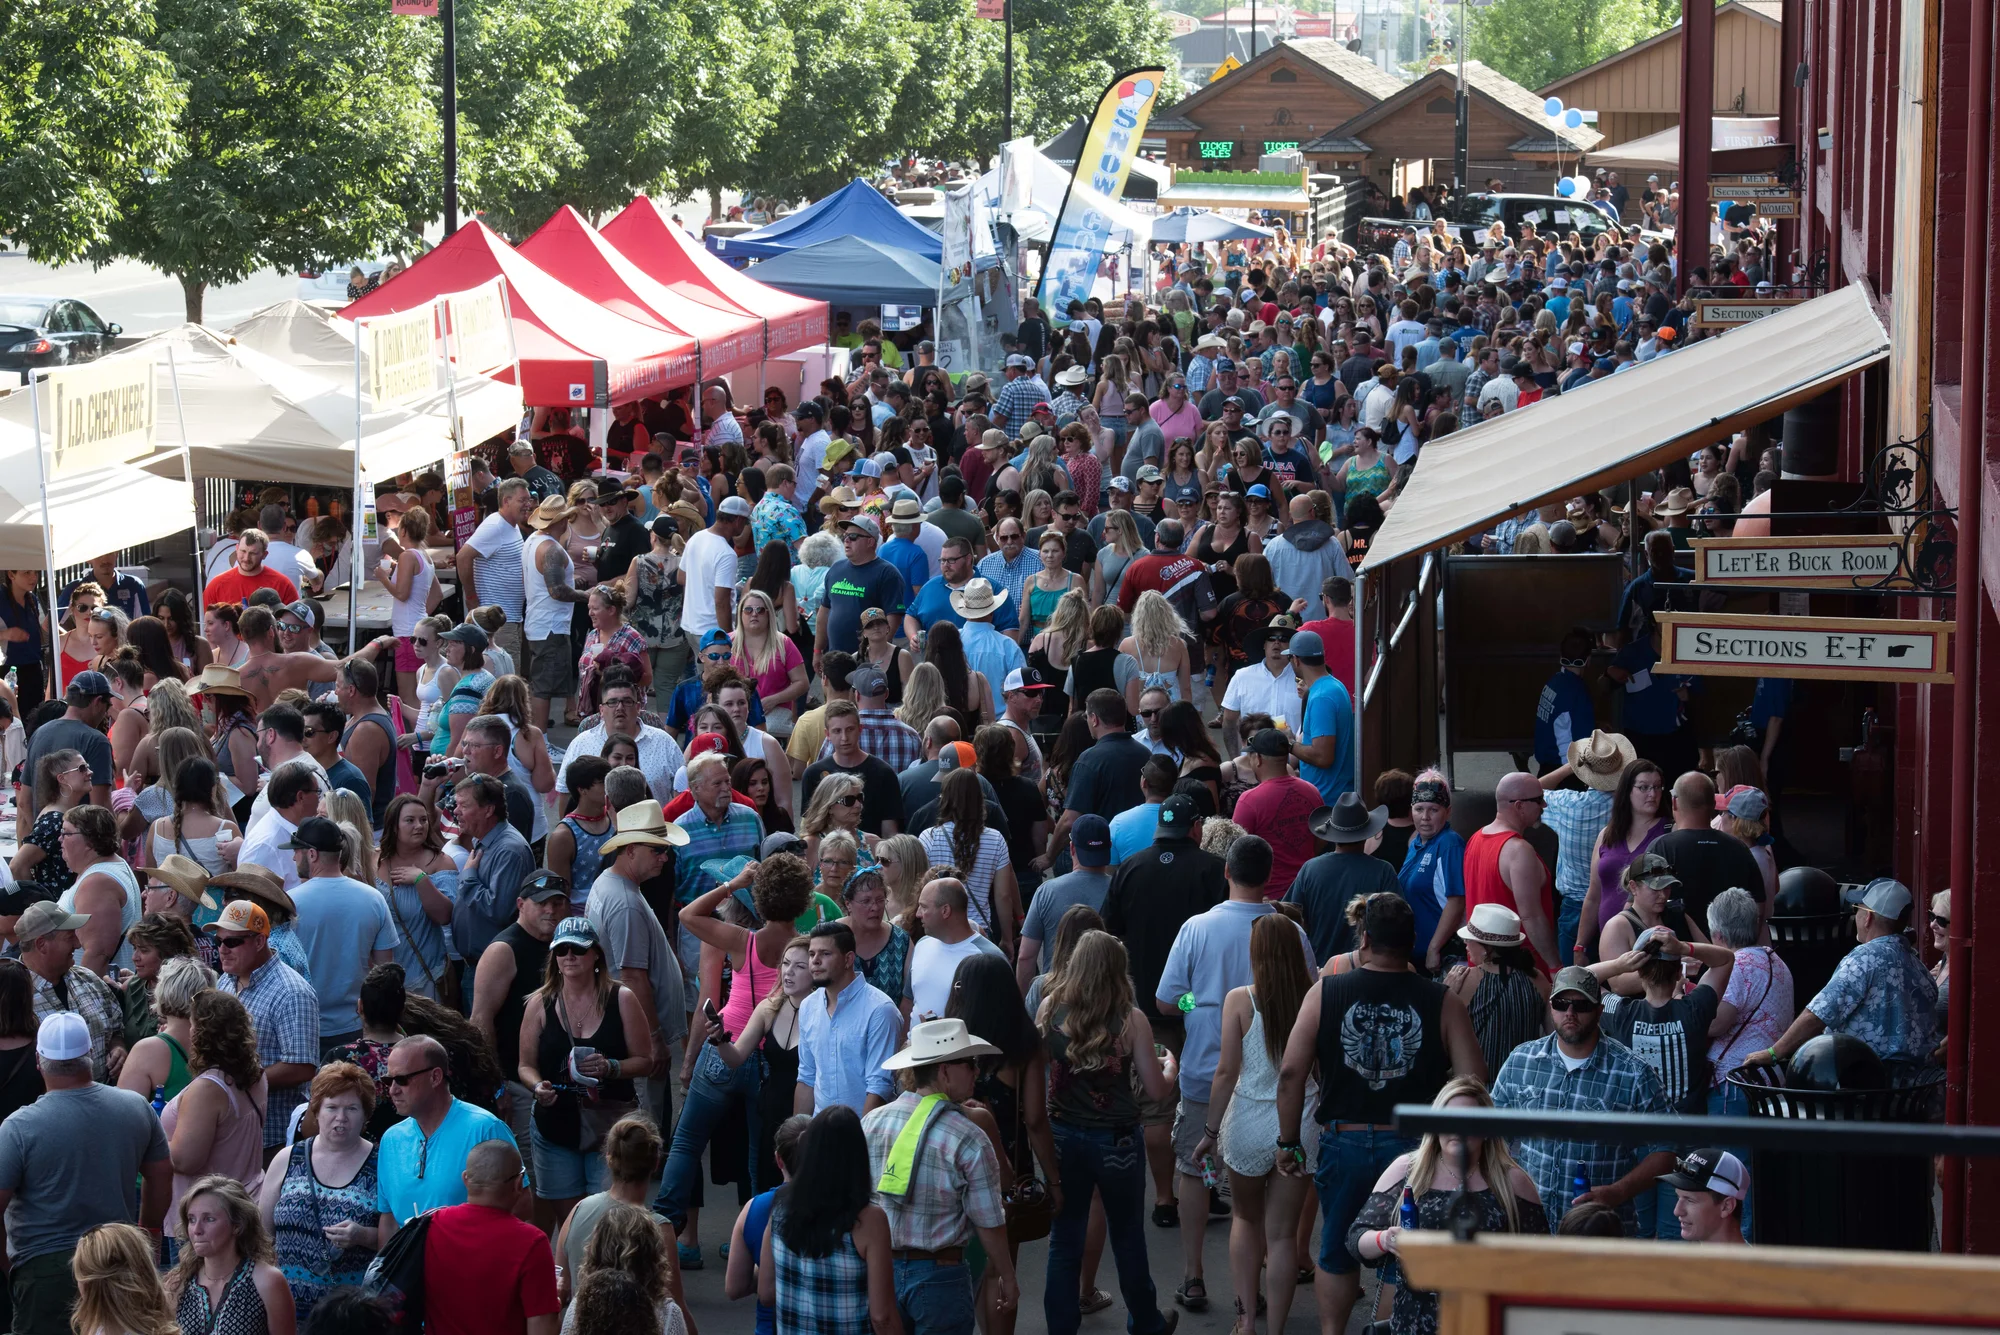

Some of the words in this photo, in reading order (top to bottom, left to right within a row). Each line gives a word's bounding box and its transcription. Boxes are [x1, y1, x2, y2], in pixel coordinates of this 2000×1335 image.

[1199, 141, 1234, 150] TICKET
[1264, 141, 1299, 150] TICKET
[1723, 135, 1754, 147] FIRST
[1091, 104, 1138, 197] SNOW
[1201, 150, 1231, 158] SALES
[1745, 175, 1766, 183] MEN
[1760, 204, 1793, 214] WOMEN
[1711, 307, 1764, 319] SECTIONS
[771, 322, 801, 346] PENDLETON
[805, 315, 826, 337] WHISKY
[704, 340, 738, 369] PENDLETON
[740, 331, 762, 357] WHISKY
[616, 361, 660, 393] PENDLETON
[665, 354, 693, 379] WHISKY
[67, 397, 85, 449] I.D.
[88, 388, 121, 443] CHECK
[122, 382, 145, 434] HERE
[1262, 460, 1295, 472] USA
[532, 474, 561, 490] RUSH
[455, 513, 465, 526] ALL
[465, 510, 476, 523] BARS
[1353, 538, 1368, 549] MR.
[1788, 551, 1832, 572] BUCK
[1841, 550, 1888, 570] ROOM
[830, 588, 865, 598] SEAHAWKS
[1694, 631, 1808, 658] SECTIONS
[1824, 635, 1877, 661] E-F
[558, 919, 589, 936] ITALIA
[1633, 1020, 1685, 1036] FREEDOM
